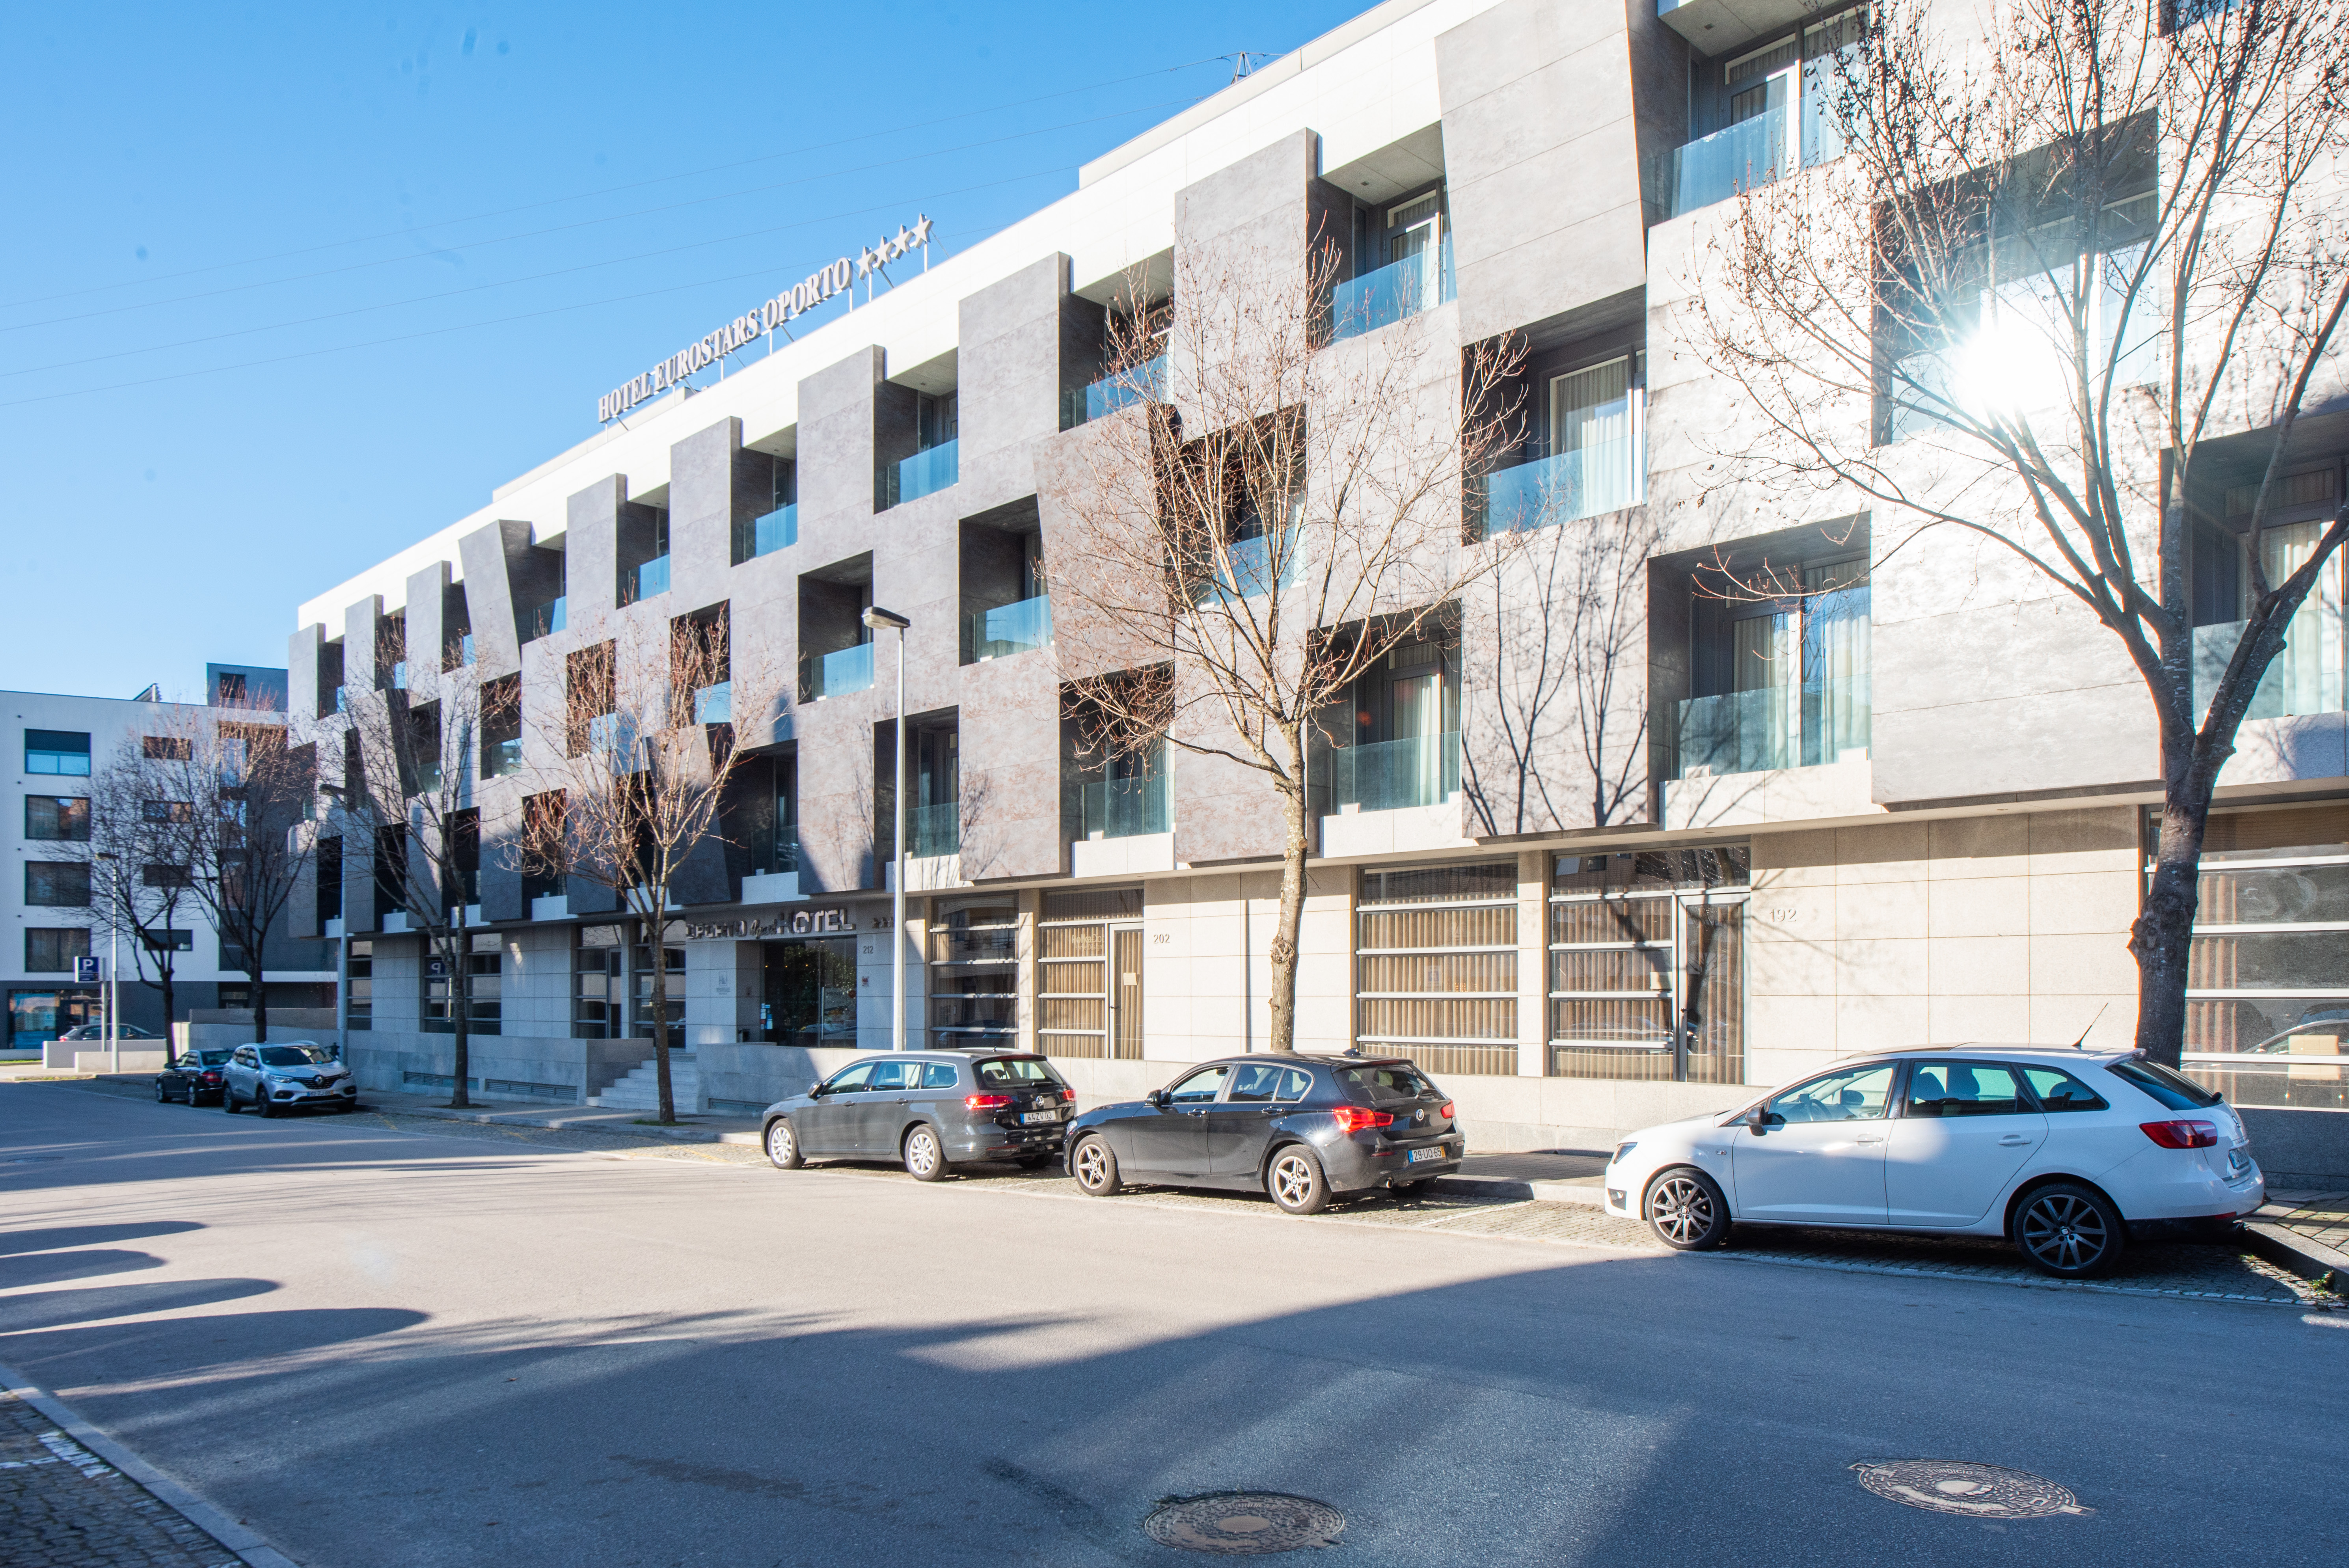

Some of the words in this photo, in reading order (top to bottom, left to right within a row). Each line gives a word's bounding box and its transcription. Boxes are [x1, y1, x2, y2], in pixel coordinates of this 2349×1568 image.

[598, 372, 654, 423] HOTEL
[654, 307, 761, 392] EUROSTARS
[762, 257, 853, 330] OPORTO
[776, 908, 856, 935] HOTEL
[1770, 909, 1796, 922] 192
[1153, 934, 1170, 944] 202
[863, 946, 874, 954] 212
[82, 959, 94, 970] P
